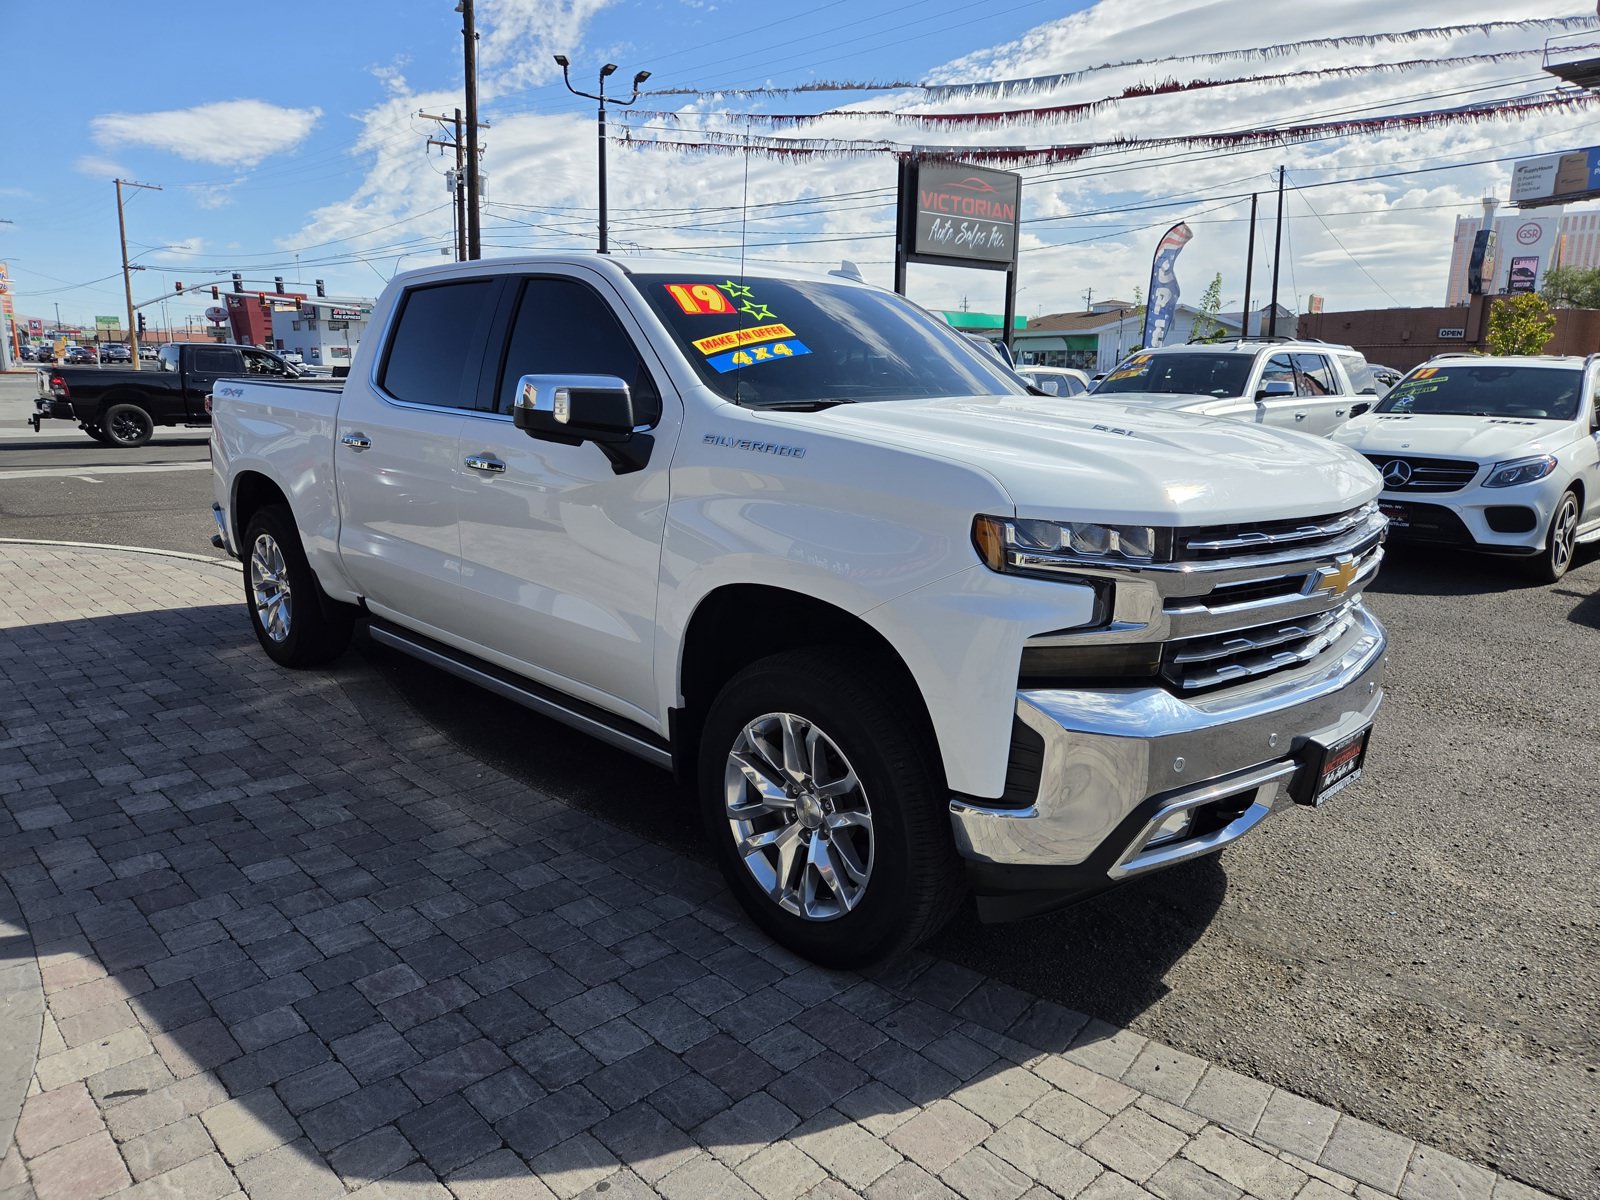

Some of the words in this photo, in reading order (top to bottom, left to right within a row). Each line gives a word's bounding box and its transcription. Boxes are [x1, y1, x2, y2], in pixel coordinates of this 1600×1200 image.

[920, 190, 1015, 221] VICTORIAN
[928, 217, 954, 245] Auto
[955, 221, 985, 250] Sales
[1519, 228, 1539, 239] GSR
[669, 285, 727, 313] 19
[700, 332, 735, 351] MAKE
[736, 328, 753, 344] AN
[755, 324, 787, 341] OFFER
[1440, 329, 1463, 338] OPEN
[703, 434, 807, 459] SILVERADO
